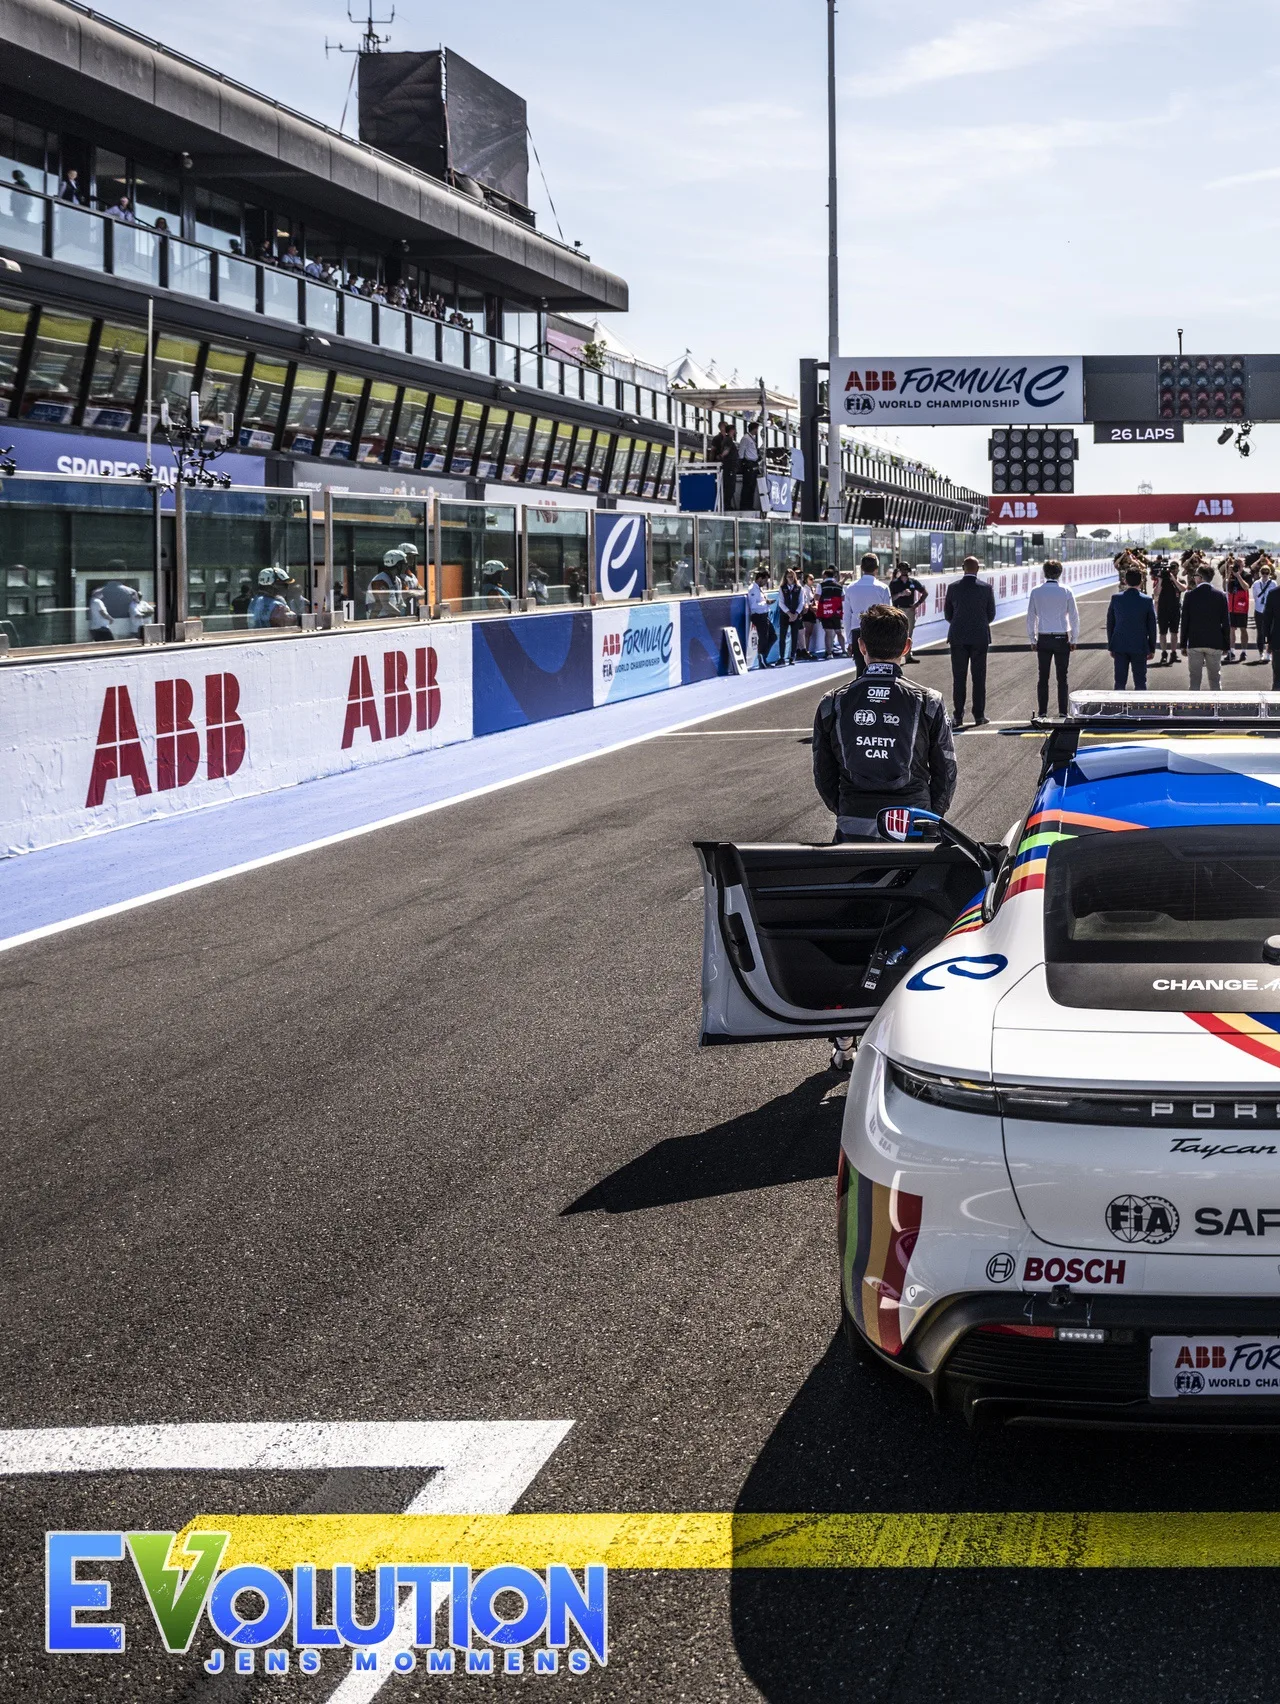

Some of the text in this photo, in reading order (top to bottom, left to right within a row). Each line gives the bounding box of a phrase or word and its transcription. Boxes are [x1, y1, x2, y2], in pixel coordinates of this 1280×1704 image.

[844, 370, 897, 392] ABB
[899, 366, 1028, 395] FORMULA
[879, 400, 922, 409] WORLD
[926, 399, 1020, 409] CHAMPIONSHIP
[1111, 428, 1175, 440] 26 LAPS
[999, 501, 1039, 519] ABB
[1194, 499, 1235, 517] ABB
[601, 633, 621, 657] ABB
[620, 625, 662, 657] FORMULA
[614, 662, 630, 674] WORLD
[630, 657, 661, 671] CHAMPIONSHIP
[341, 646, 443, 750] ABB
[867, 688, 891, 698] OMP
[85, 671, 247, 809] ABB
[856, 736, 896, 748] SAFETY
[865, 749, 889, 759] CAR
[1170, 1137, 1278, 1160] Taycan
[1023, 1257, 1126, 1285] BOSCH
[1174, 1346, 1227, 1369] ABB
[1208, 1378, 1251, 1388] WORLD
